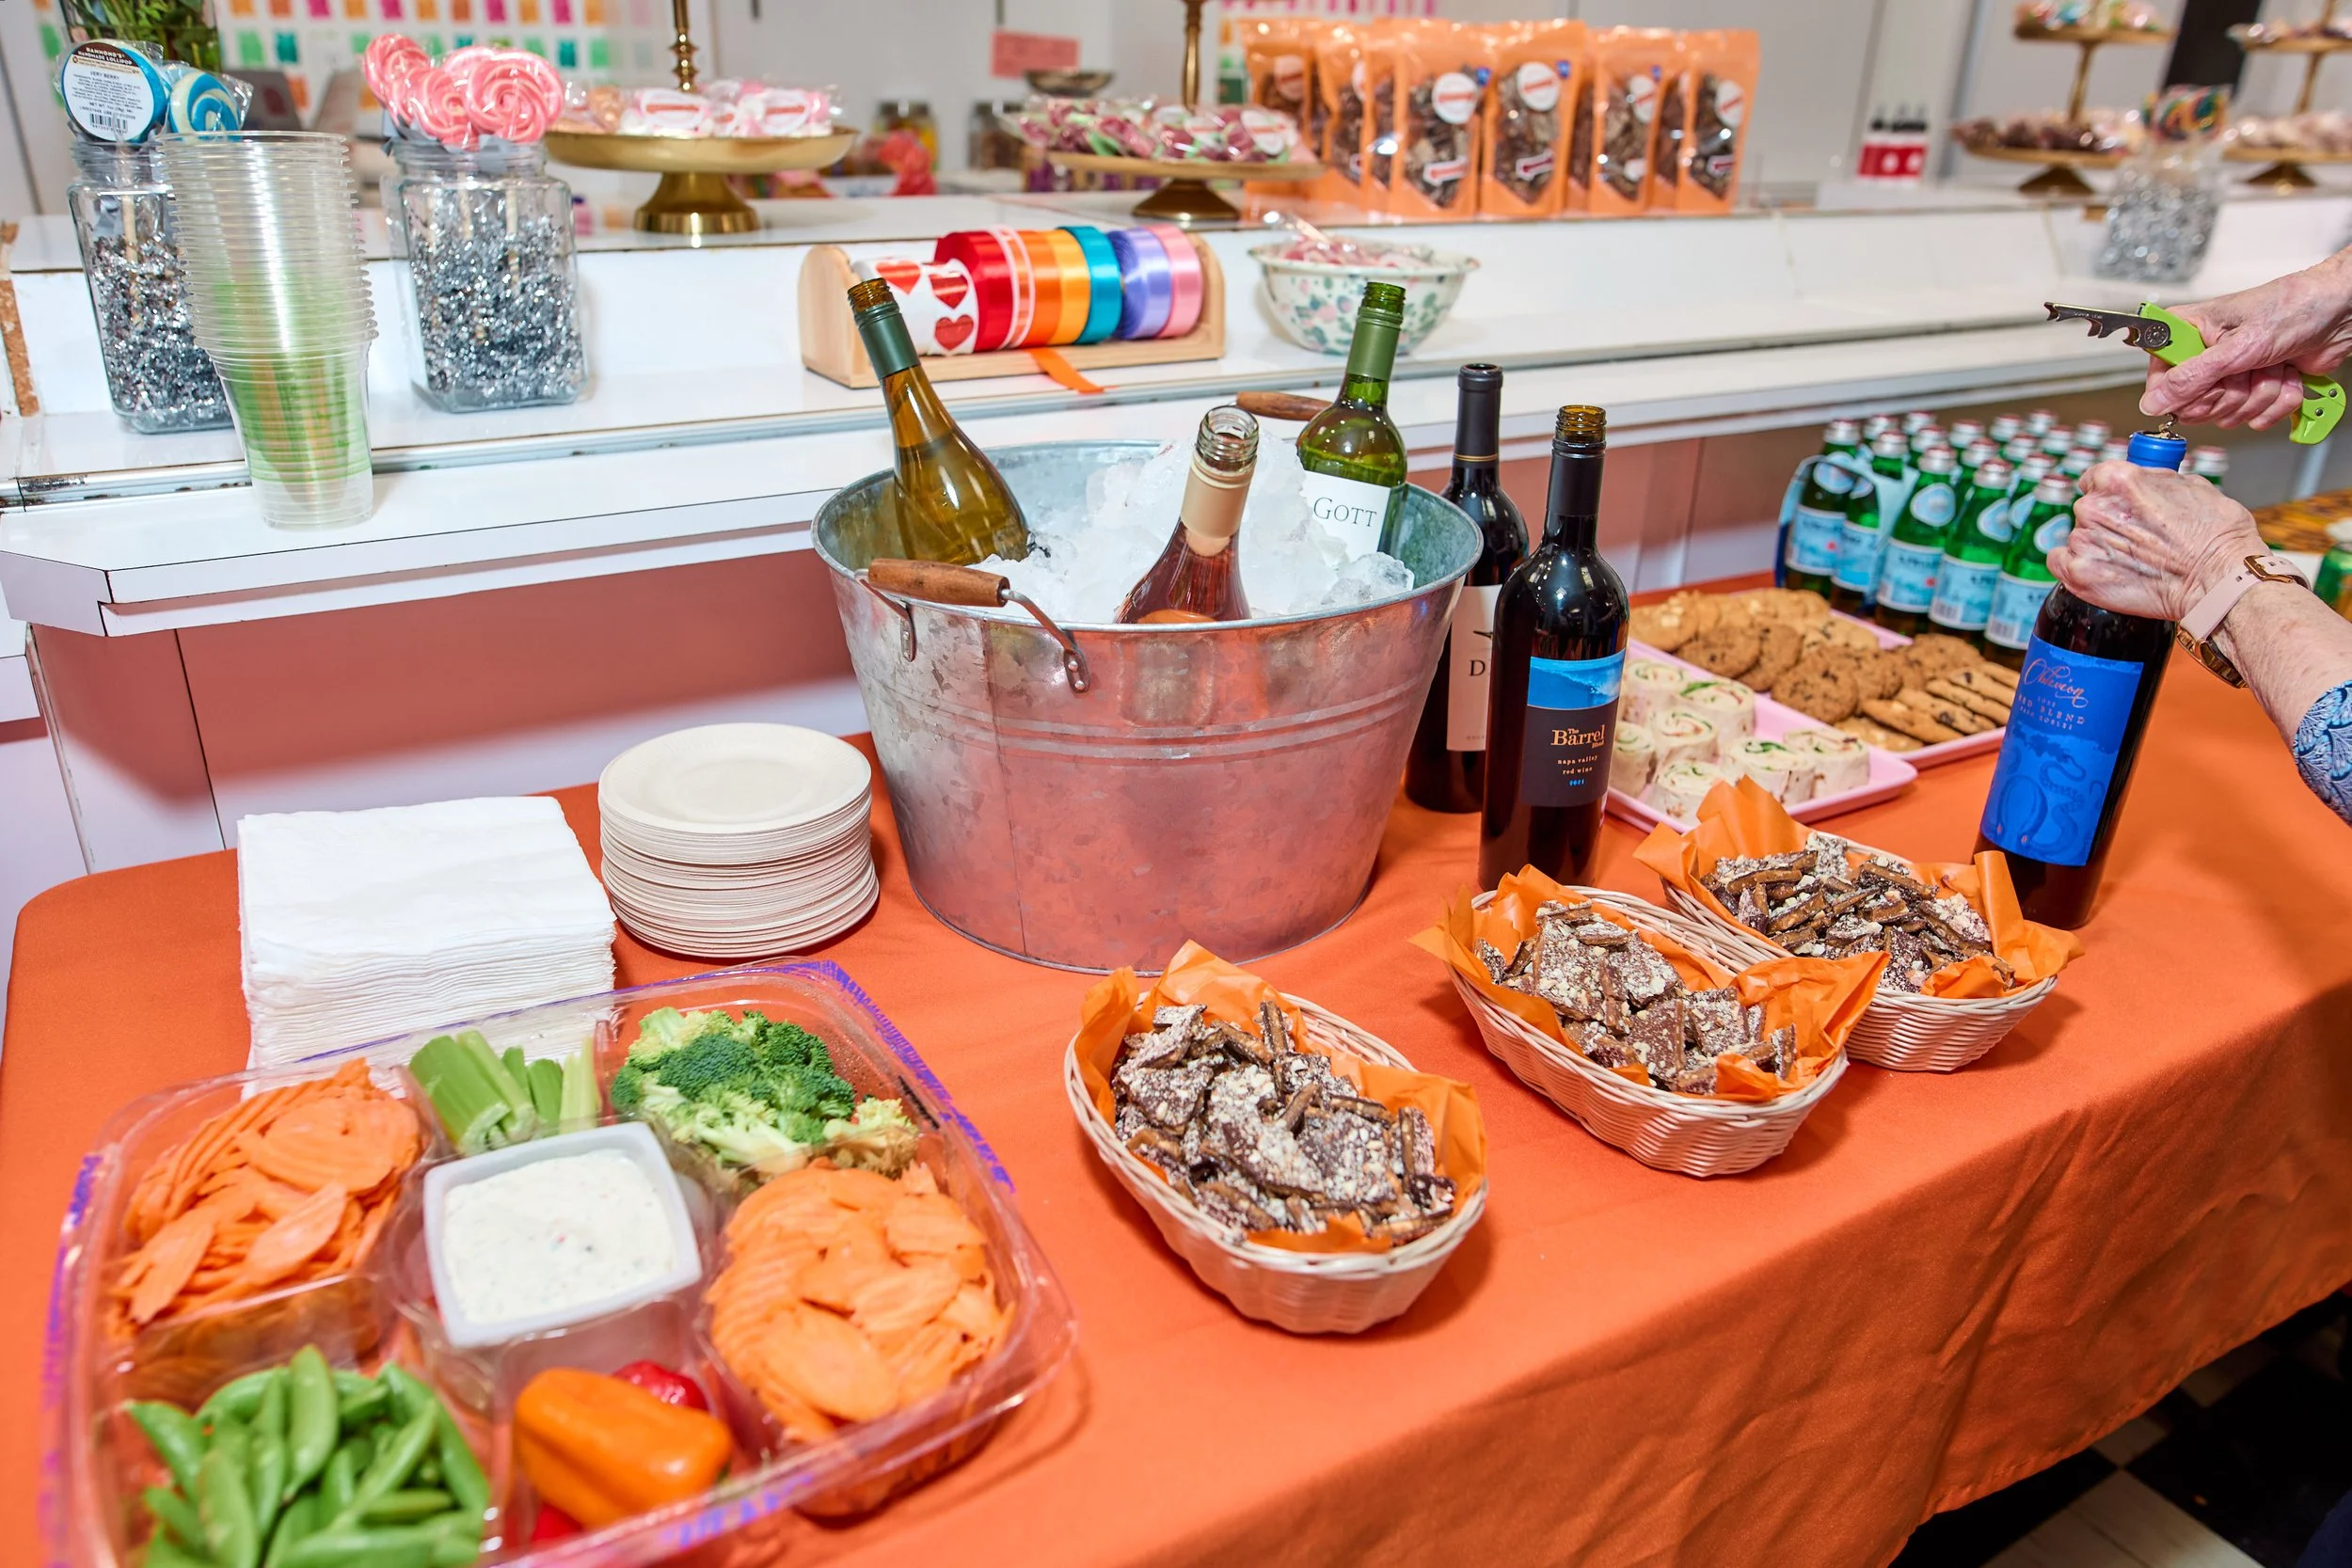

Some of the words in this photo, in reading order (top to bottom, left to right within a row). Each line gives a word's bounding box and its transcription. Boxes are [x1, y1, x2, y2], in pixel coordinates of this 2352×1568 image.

[78, 51, 105, 60] HANDMADE
[106, 56, 133, 65] LOLLIPOP
[2019, 694, 2032, 707] RED
[2041, 705, 2085, 724] BLEND
[1550, 723, 1605, 746] Barrel
[1578, 755, 1597, 764] valley
